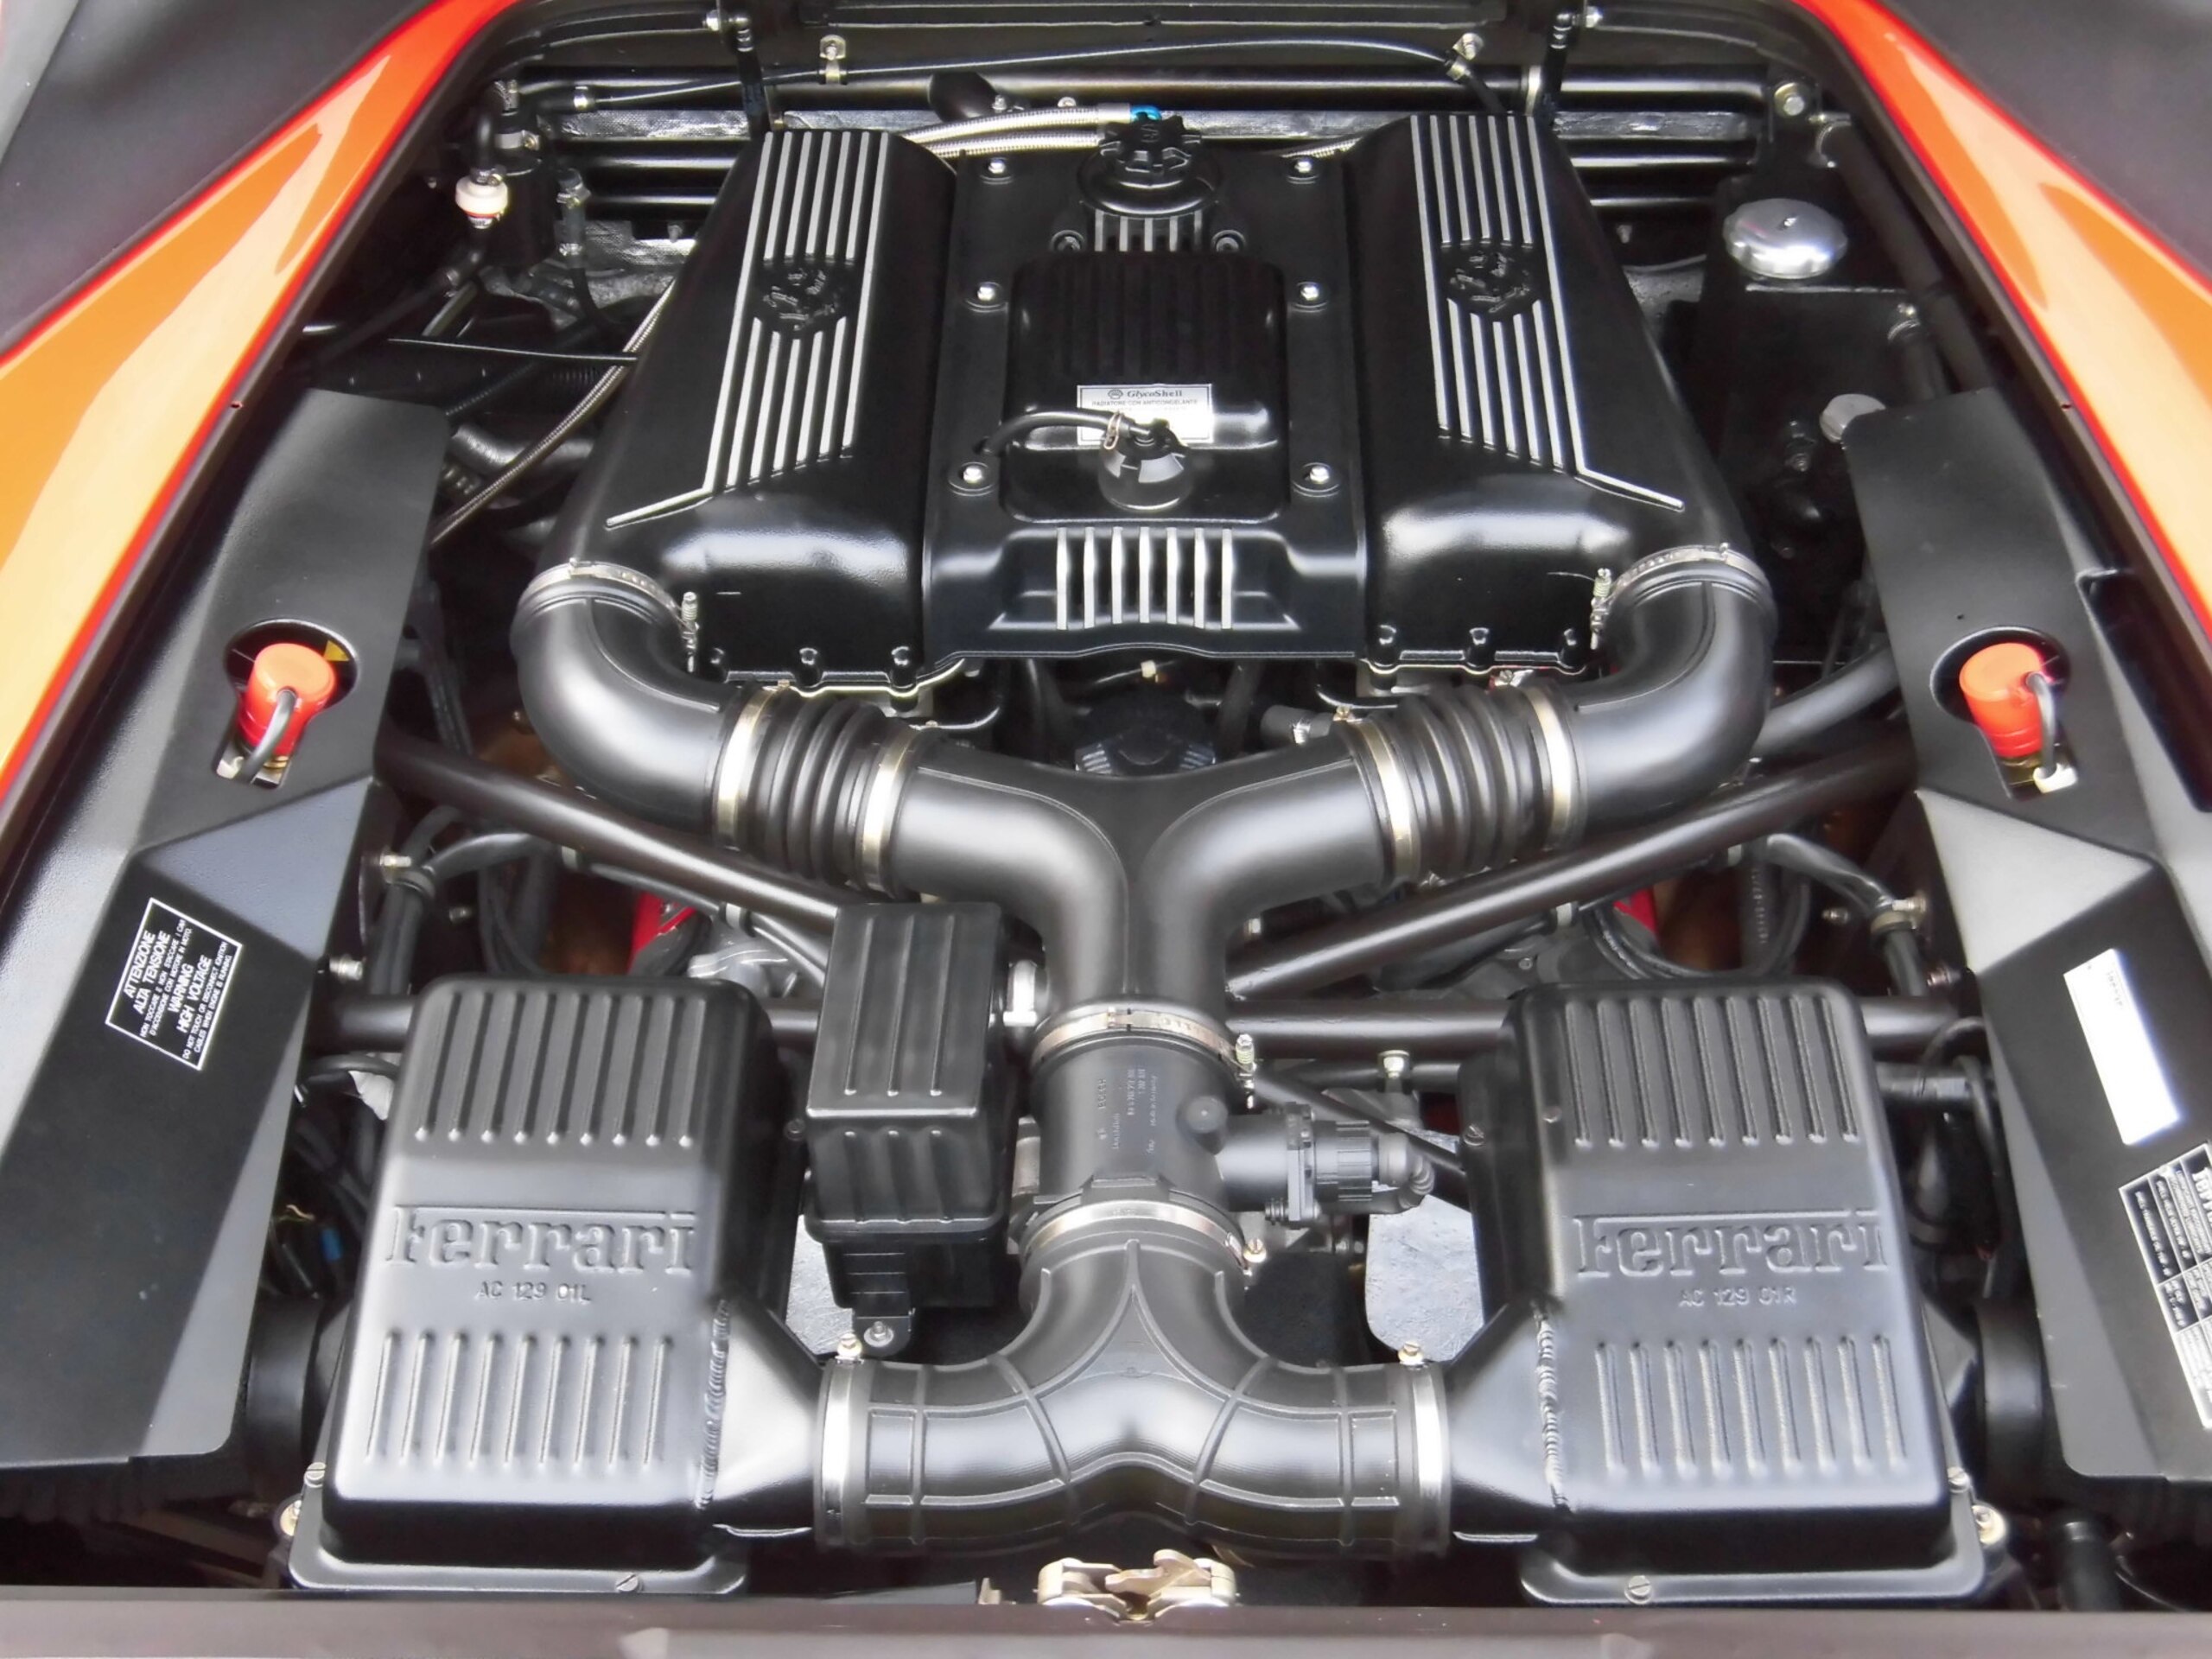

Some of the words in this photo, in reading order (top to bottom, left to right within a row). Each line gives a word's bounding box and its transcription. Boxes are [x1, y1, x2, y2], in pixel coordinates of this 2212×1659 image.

[1127, 389, 1183, 398] GlycoShell
[124, 931, 156, 997] ATTENZIONE
[132, 987, 150, 1014] ALTA
[143, 931, 170, 984] TENSIONE
[145, 994, 159, 1020] TOCCARE
[164, 938, 179, 967] STACCARE
[165, 978, 174, 991] CON
[168, 963, 194, 1013] WARNING
[176, 1005, 194, 1033] HIGH
[188, 955, 212, 1001] VOLTAGE
[182, 1049, 190, 1058] DO
[191, 1014, 202, 1033] TOUCH
[199, 1003, 206, 1013] OR
[203, 967, 219, 1001] DISCONNECT
[214, 941, 227, 965] IGNITION
[194, 1029, 206, 1052] CABLES
[202, 1010, 213, 1027] WHEN
[209, 988, 219, 1008] ENGINE
[385, 1205, 696, 1275] Ferrari
[1573, 1210, 1889, 1278] Ferrari
[474, 1280, 503, 1300] AC
[512, 1281, 547, 1300] 129
[1678, 1287, 1705, 1307] AC
[1713, 1287, 1750, 1306] 129
